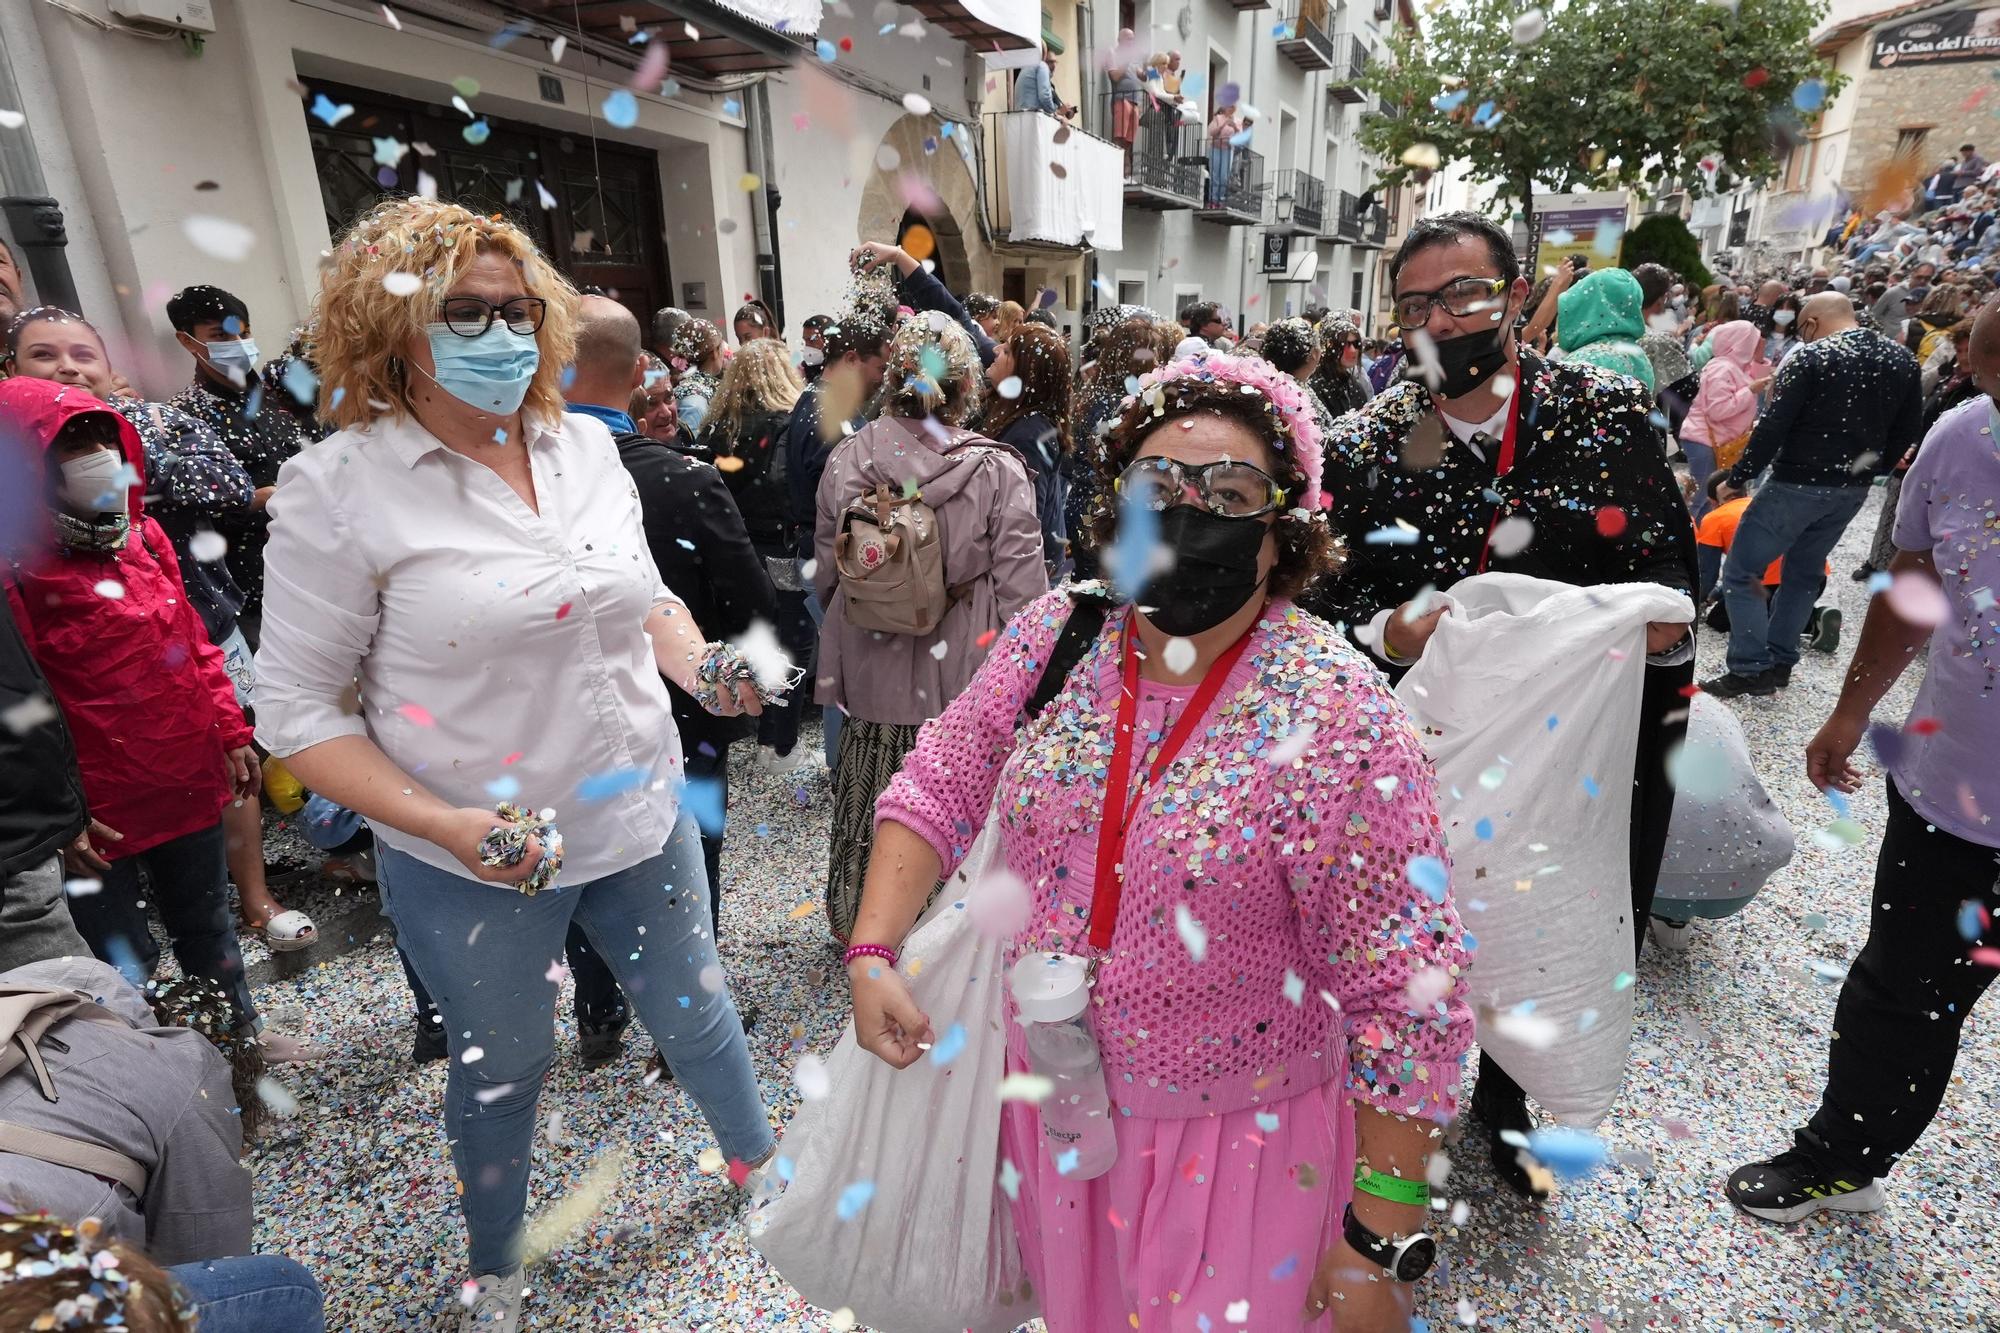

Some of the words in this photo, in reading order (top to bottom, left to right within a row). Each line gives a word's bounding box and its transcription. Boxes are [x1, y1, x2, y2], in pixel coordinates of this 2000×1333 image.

[1876, 42, 1896, 55] La
[1897, 40, 1934, 53] Casa
[1935, 36, 1961, 50] del
